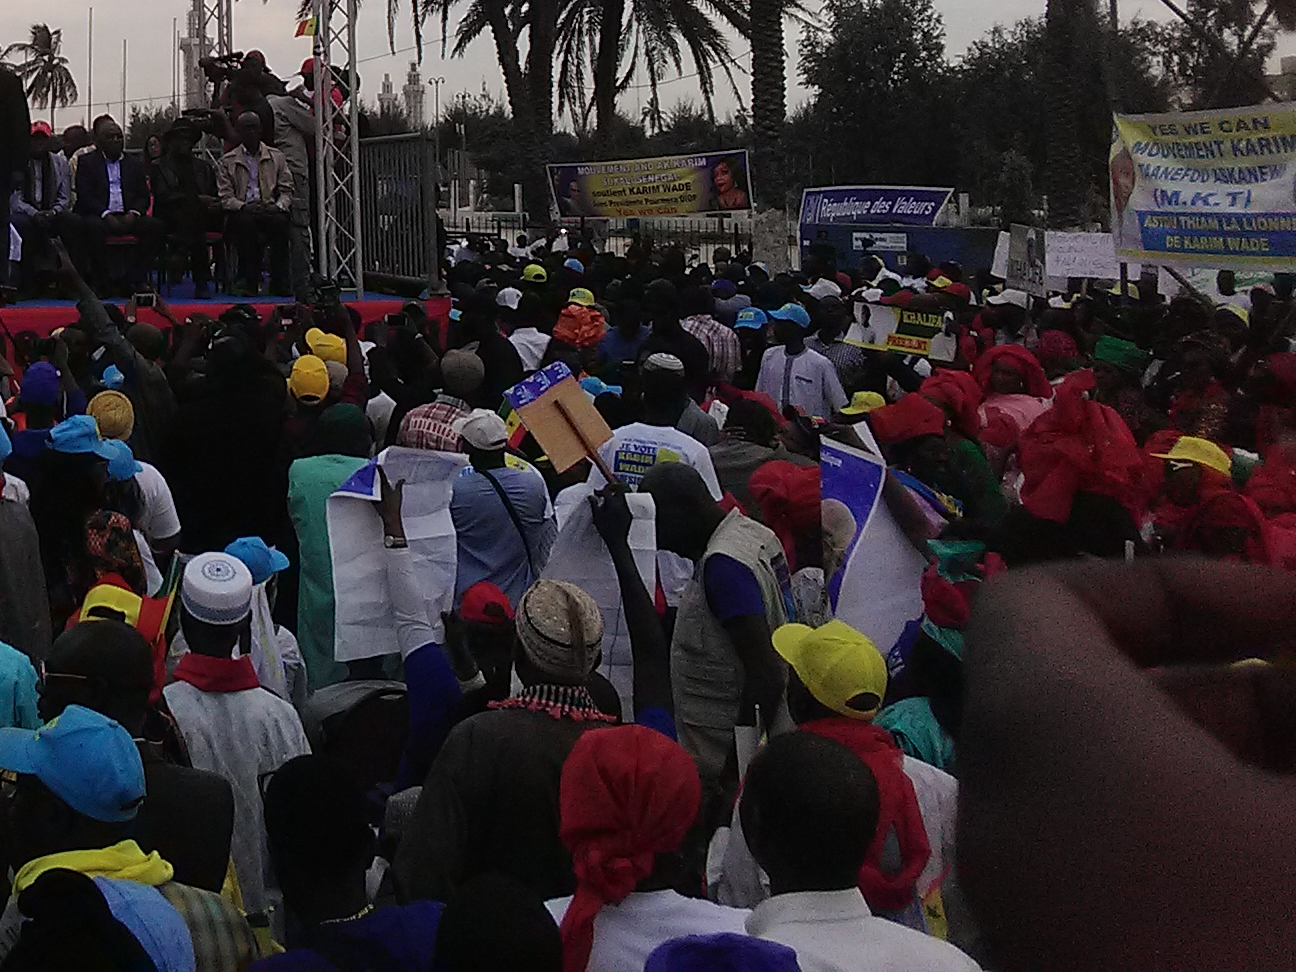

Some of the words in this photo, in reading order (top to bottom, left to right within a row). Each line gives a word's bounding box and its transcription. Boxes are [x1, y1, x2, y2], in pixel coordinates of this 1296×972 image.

[1148, 123, 1179, 136] YES
[1183, 121, 1212, 135] WE
[1218, 116, 1271, 133] CAN
[577, 163, 632, 175] MOUVEMENT
[673, 157, 707, 168] KARIM
[628, 184, 660, 195] KARIM
[662, 182, 692, 193] WADE
[820, 196, 871, 222] République
[871, 196, 892, 214] des
[891, 196, 936, 216] Valeurs
[1222, 217, 1241, 231] LA
[1166, 236, 1179, 249] DE
[1183, 236, 1224, 249] KARIM
[1228, 237, 1270, 251] WADE
